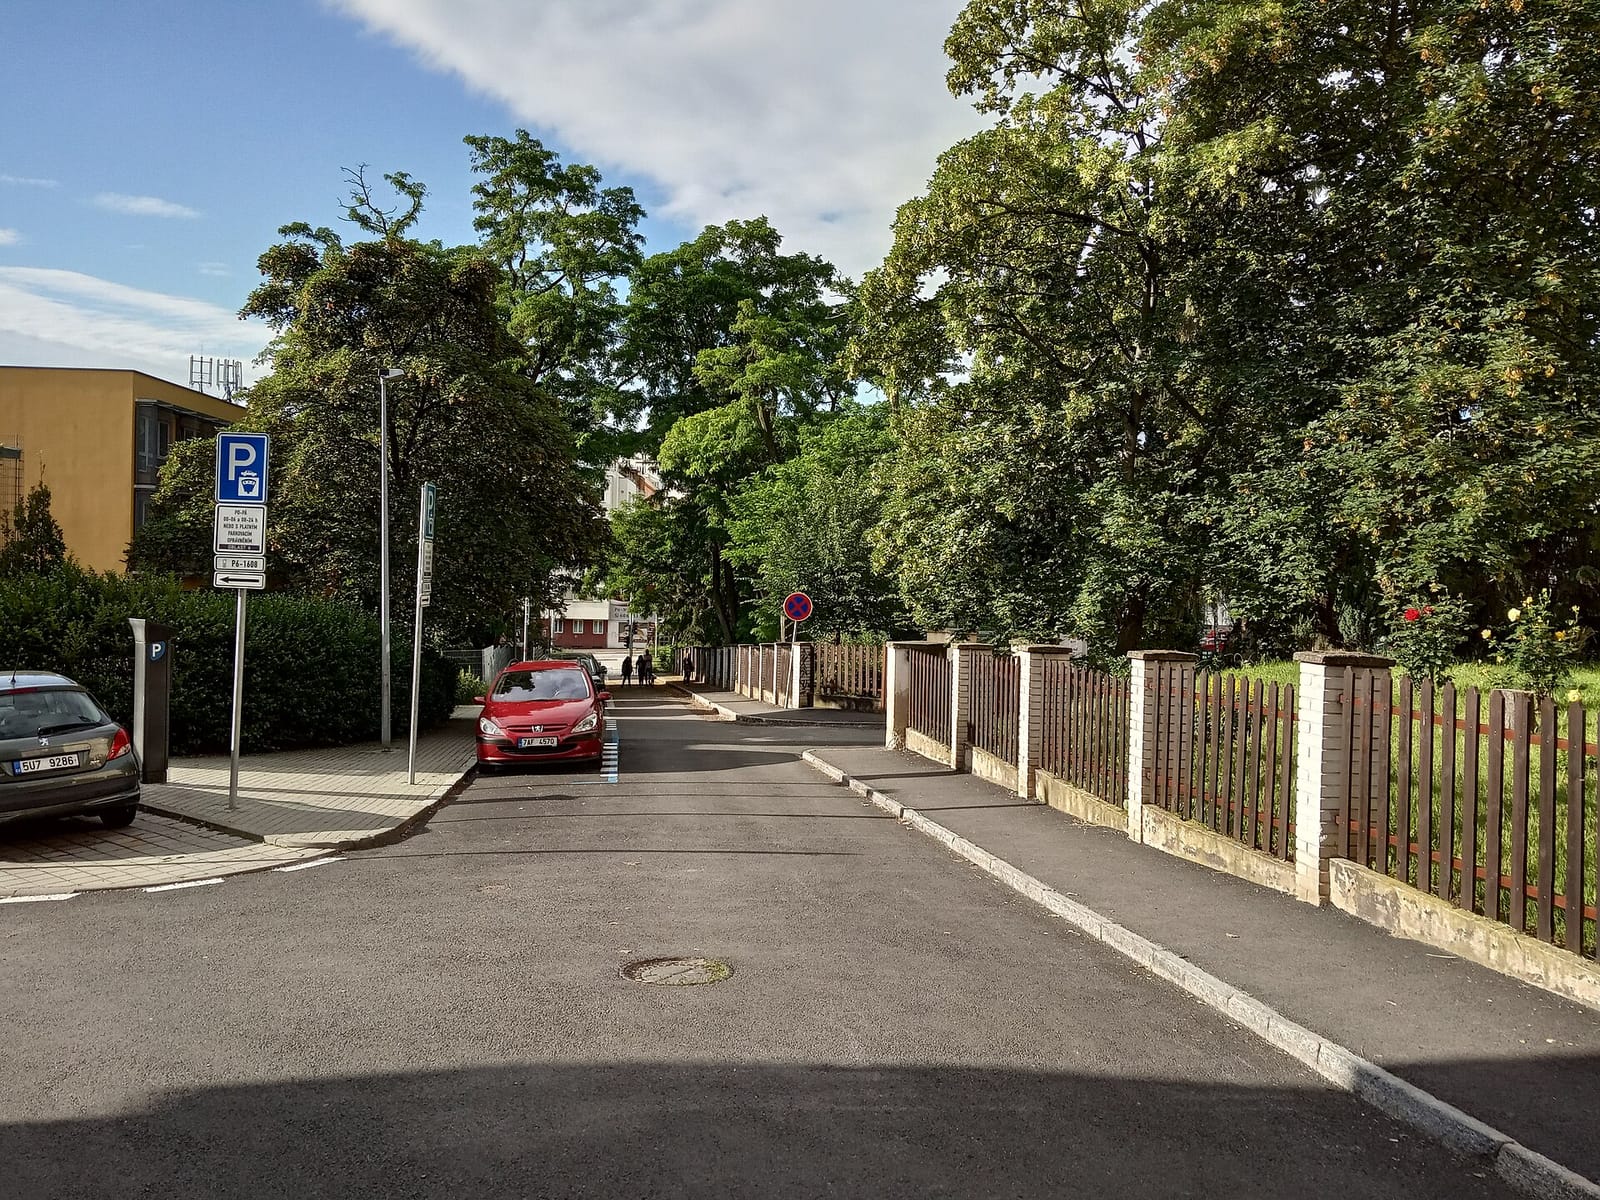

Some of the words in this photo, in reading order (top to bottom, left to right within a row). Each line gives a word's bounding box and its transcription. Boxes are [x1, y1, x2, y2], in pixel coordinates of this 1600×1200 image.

[228, 442, 257, 480] P
[231, 559, 258, 568] P6-1608
[152, 643, 162, 657] P
[22, 760, 41, 772] 5U7
[49, 756, 74, 768] 9286
